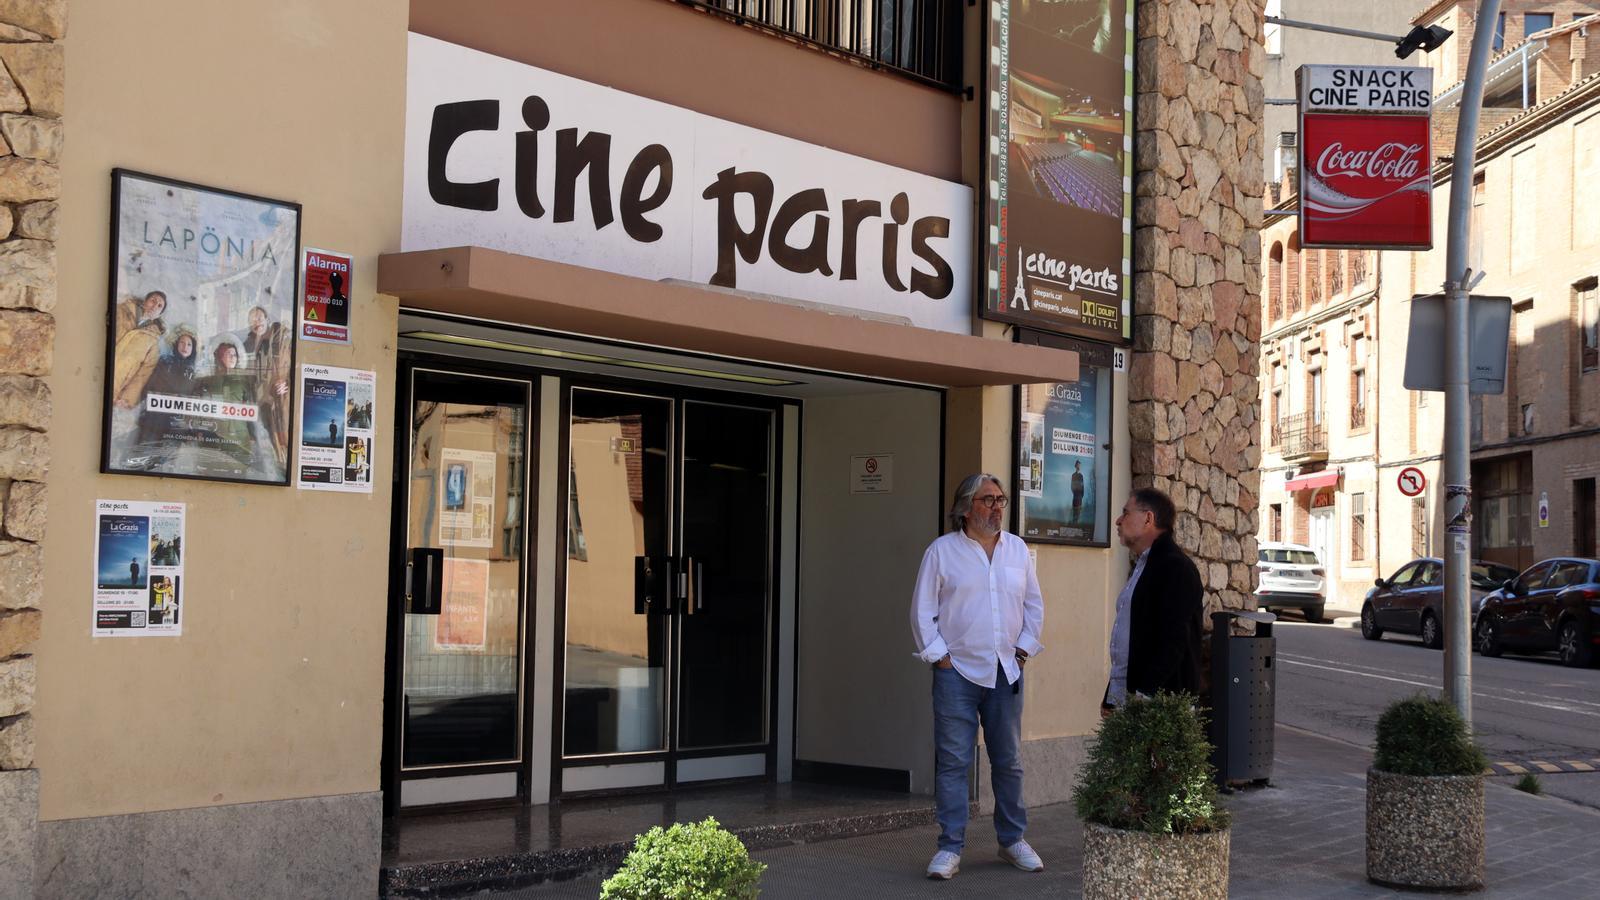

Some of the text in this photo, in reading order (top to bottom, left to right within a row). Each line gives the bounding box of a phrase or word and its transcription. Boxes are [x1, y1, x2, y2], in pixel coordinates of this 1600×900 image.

[1332, 69, 1414, 88] SNACK
[1000, 80, 1008, 125] SOLSONA
[1309, 88, 1430, 108] CINE PARIS
[1001, 128, 1007, 140] 24
[1001, 141, 1007, 153] 28
[1001, 154, 1007, 166] 48
[1316, 142, 1425, 178] Coca-Cola
[428, 95, 955, 300] cine paris
[143, 221, 277, 266] LAPÖNIA
[308, 255, 347, 272] Alarma
[1026, 252, 1067, 279] cine
[307, 294, 318, 303] 902
[319, 296, 331, 305] 200
[1033, 288, 1063, 301] cineparis.cat
[1033, 299, 1079, 316] @cineparis_solsona
[1097, 307, 1116, 318] DOLBY
[1082, 316, 1118, 330] DIGITAL
[1114, 352, 1124, 369] 19
[312, 385, 320, 393] La
[320, 386, 337, 395] Grazia
[1045, 384, 1082, 402] La Grazia
[150, 398, 255, 418] DIUMENGE 20:00
[1053, 430, 1081, 440] DIUMENGE
[1053, 442, 1079, 453] DILLUNS
[110, 523, 139, 531] La Grazia
